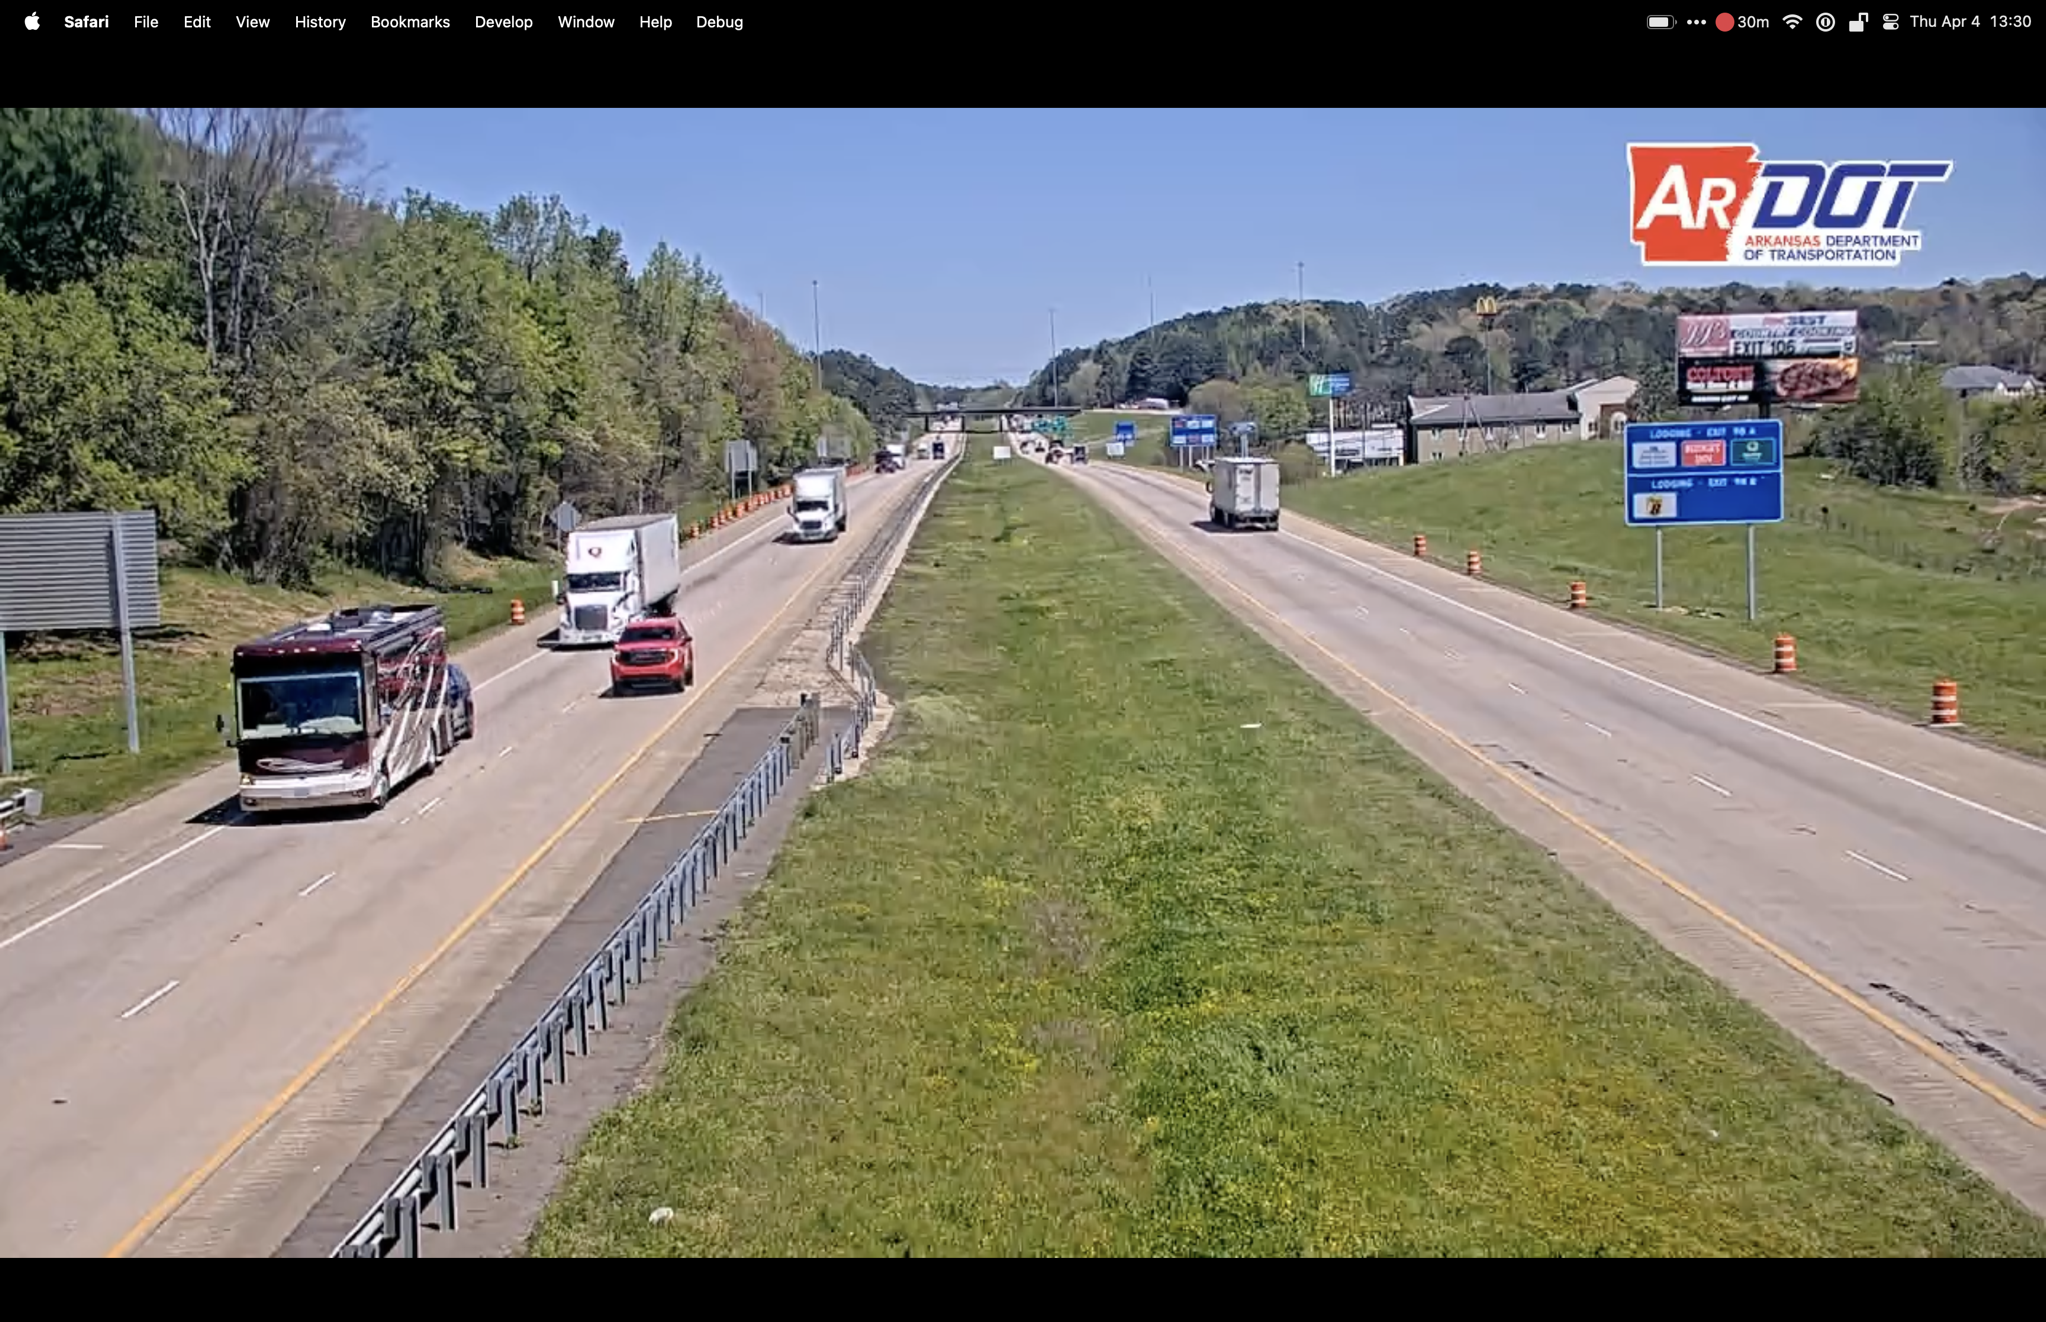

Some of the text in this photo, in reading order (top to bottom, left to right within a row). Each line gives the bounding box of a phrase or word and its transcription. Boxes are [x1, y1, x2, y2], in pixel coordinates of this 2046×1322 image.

[1733, 339, 1797, 356] EXIT 106
[1650, 427, 1692, 439] LODGING
[1706, 426, 1727, 437] EXIT
[1651, 478, 1694, 489] LODGING
[1708, 477, 1728, 488] EXIT
